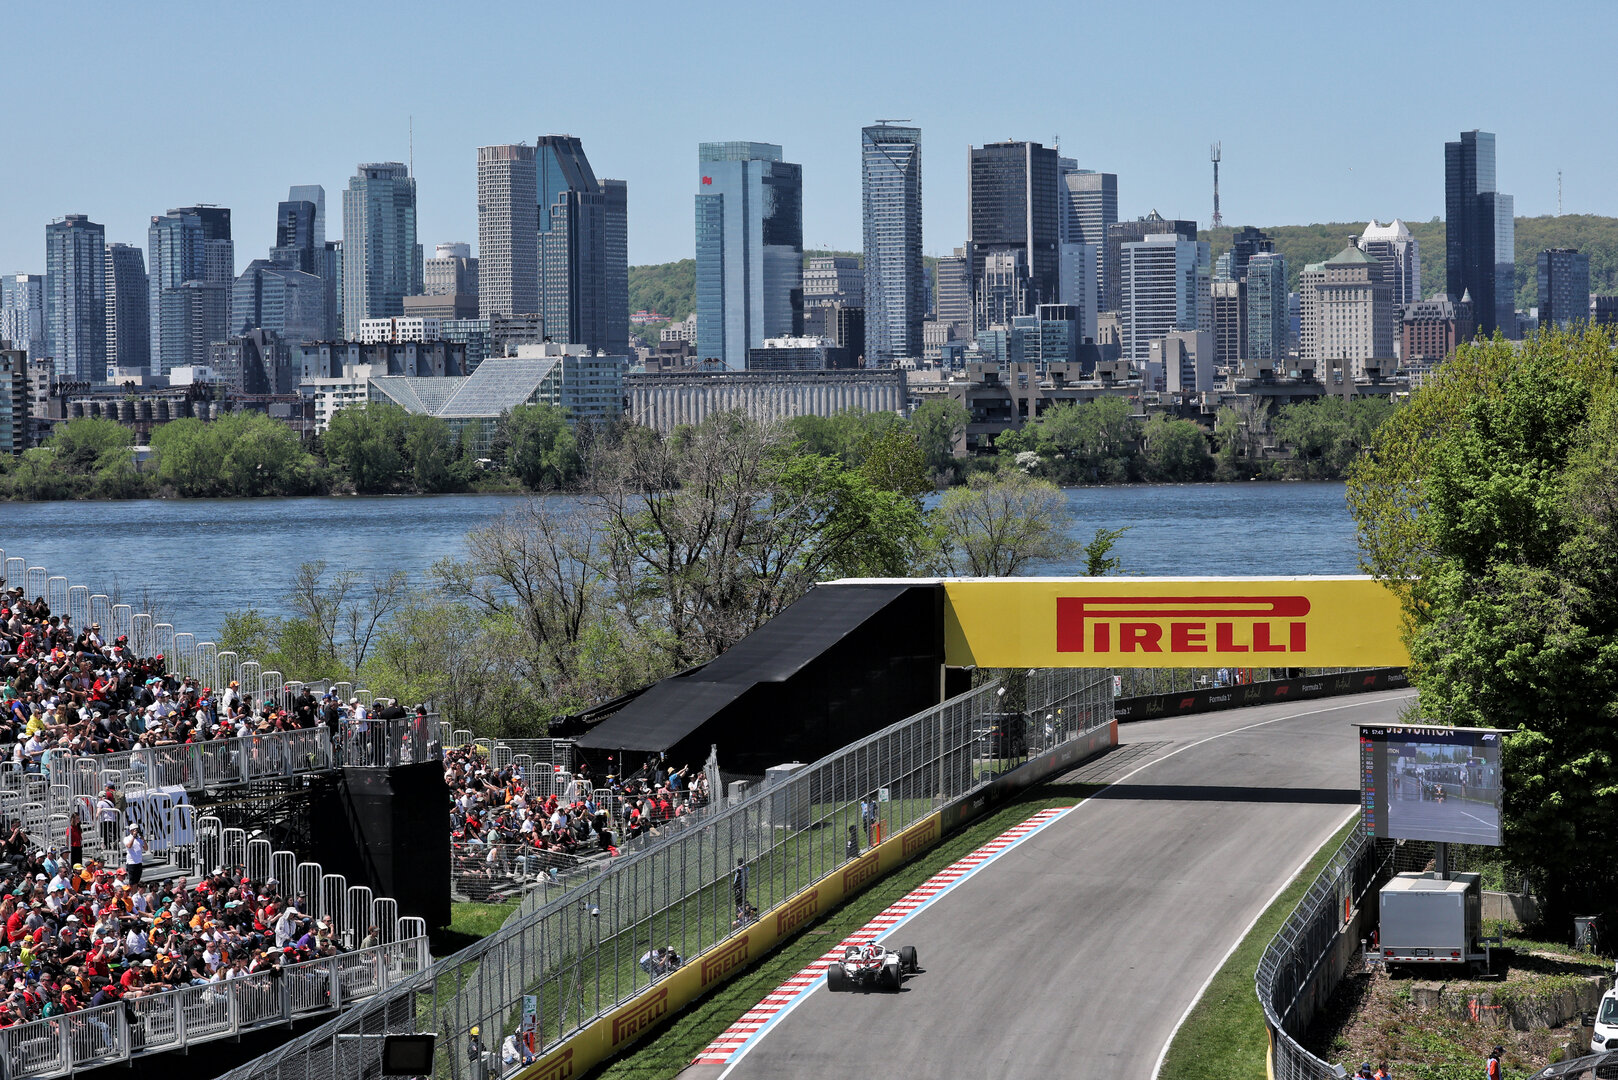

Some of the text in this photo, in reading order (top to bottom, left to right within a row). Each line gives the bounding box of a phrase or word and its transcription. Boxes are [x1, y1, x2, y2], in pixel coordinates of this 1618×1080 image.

[1056, 596, 1311, 652] PIRELLI
[1208, 694, 1226, 704] Formula
[1302, 684, 1318, 692] Formula
[902, 820, 936, 857] PIRELLI
[843, 852, 880, 894] PIRELLI
[777, 890, 818, 937] PIRELLI
[701, 935, 748, 987] PIRELLI
[612, 987, 668, 1047] PIRELLI
